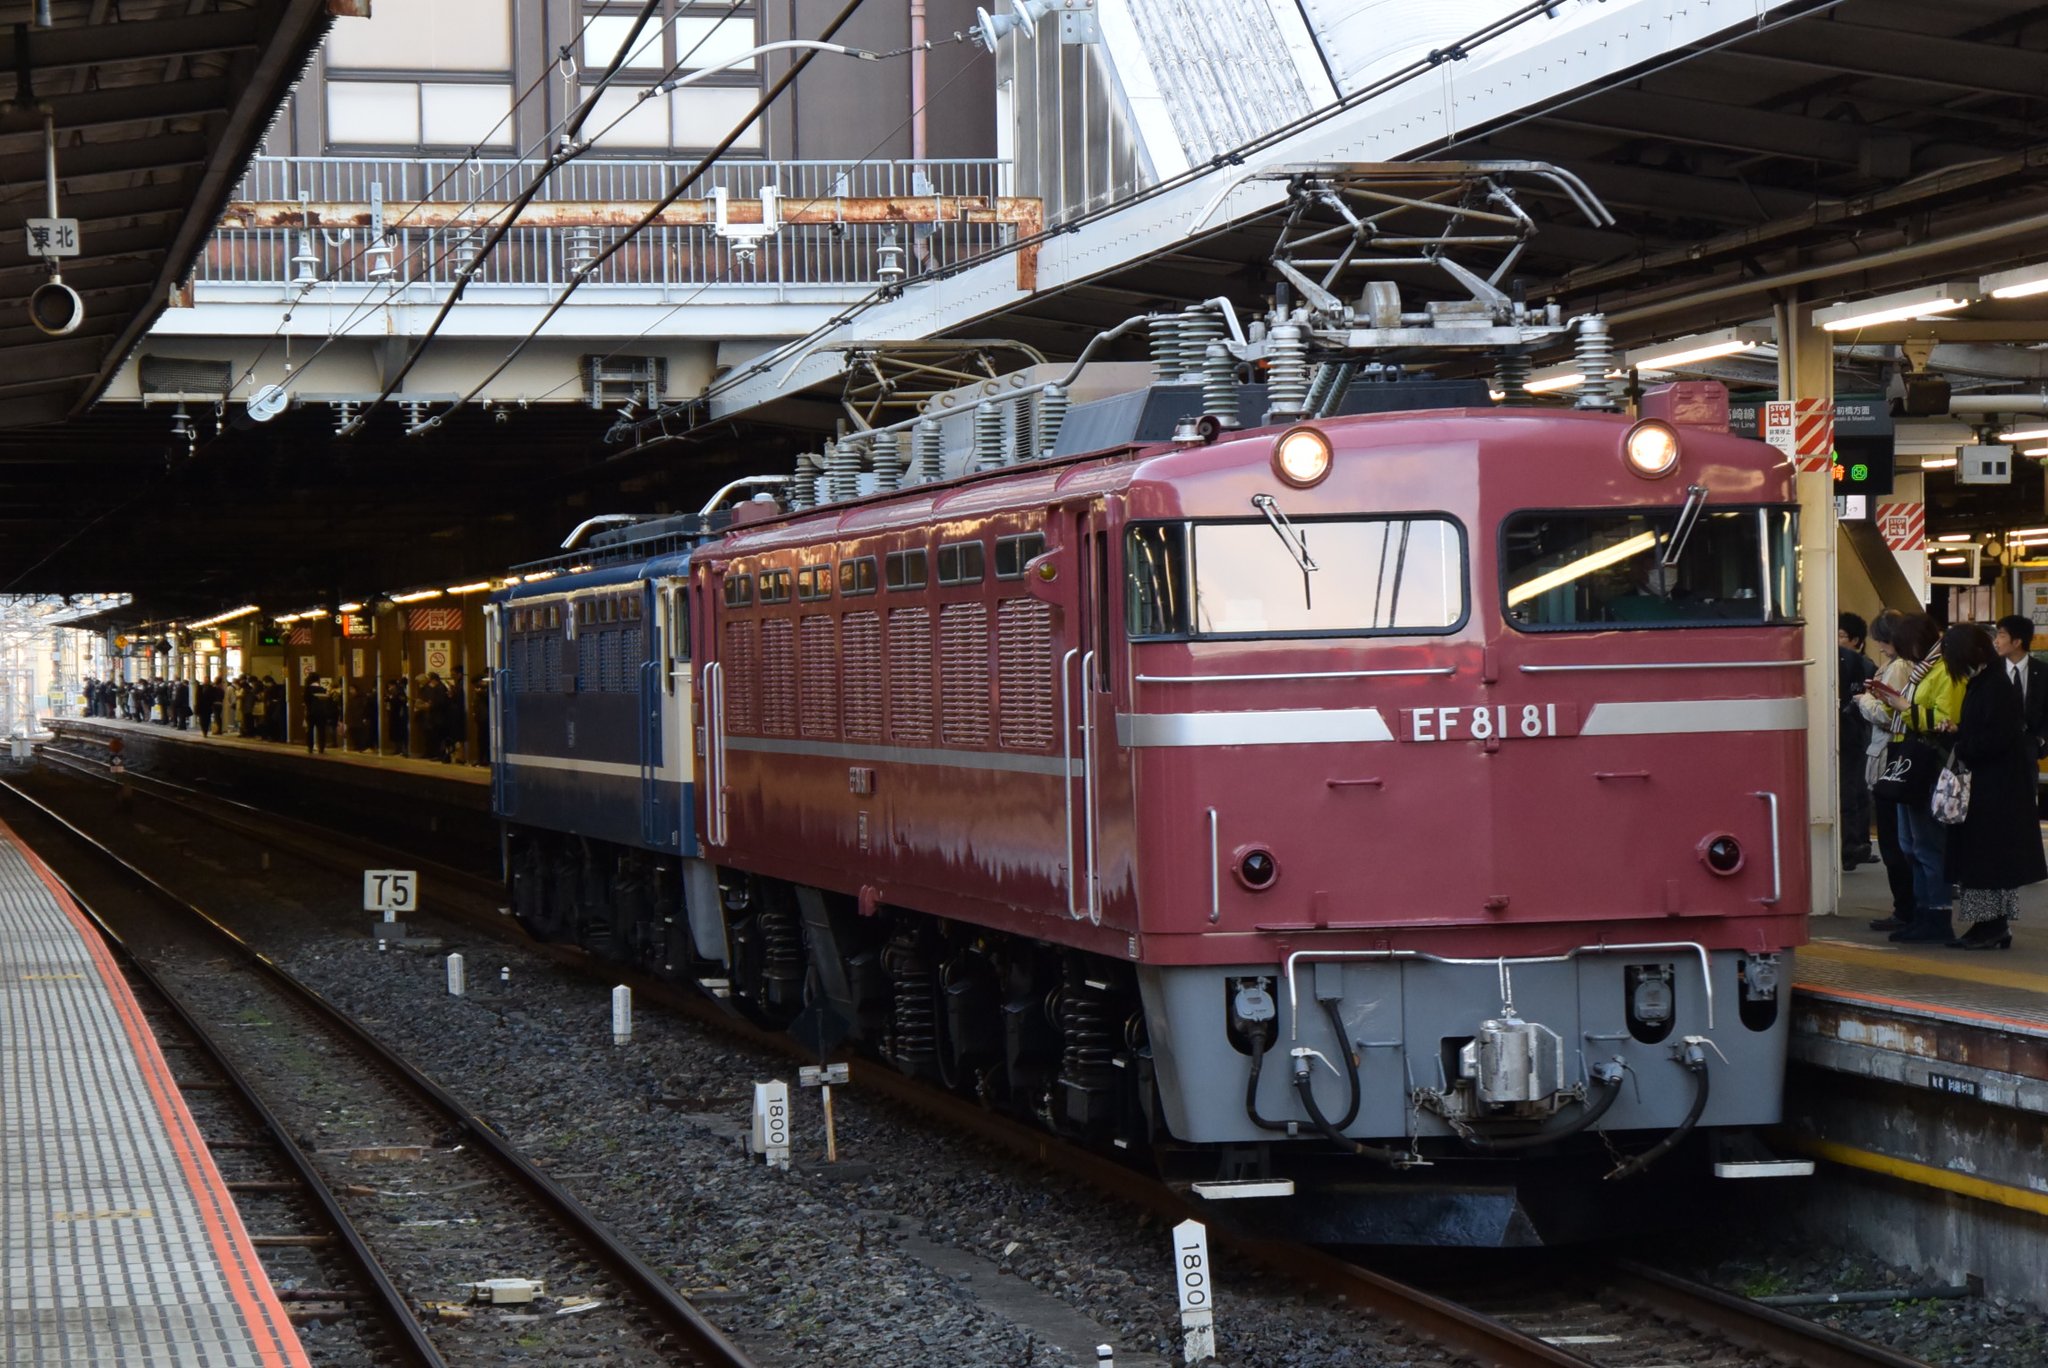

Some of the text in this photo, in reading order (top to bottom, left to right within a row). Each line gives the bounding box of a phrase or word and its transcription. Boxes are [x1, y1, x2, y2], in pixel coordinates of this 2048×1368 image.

[32, 225, 74, 251] 東北
[1413, 703, 1557, 741] EF 81 81
[372, 875, 409, 906] 75
[769, 1097, 785, 1144] 1800
[1182, 1243, 1206, 1306] 1800
